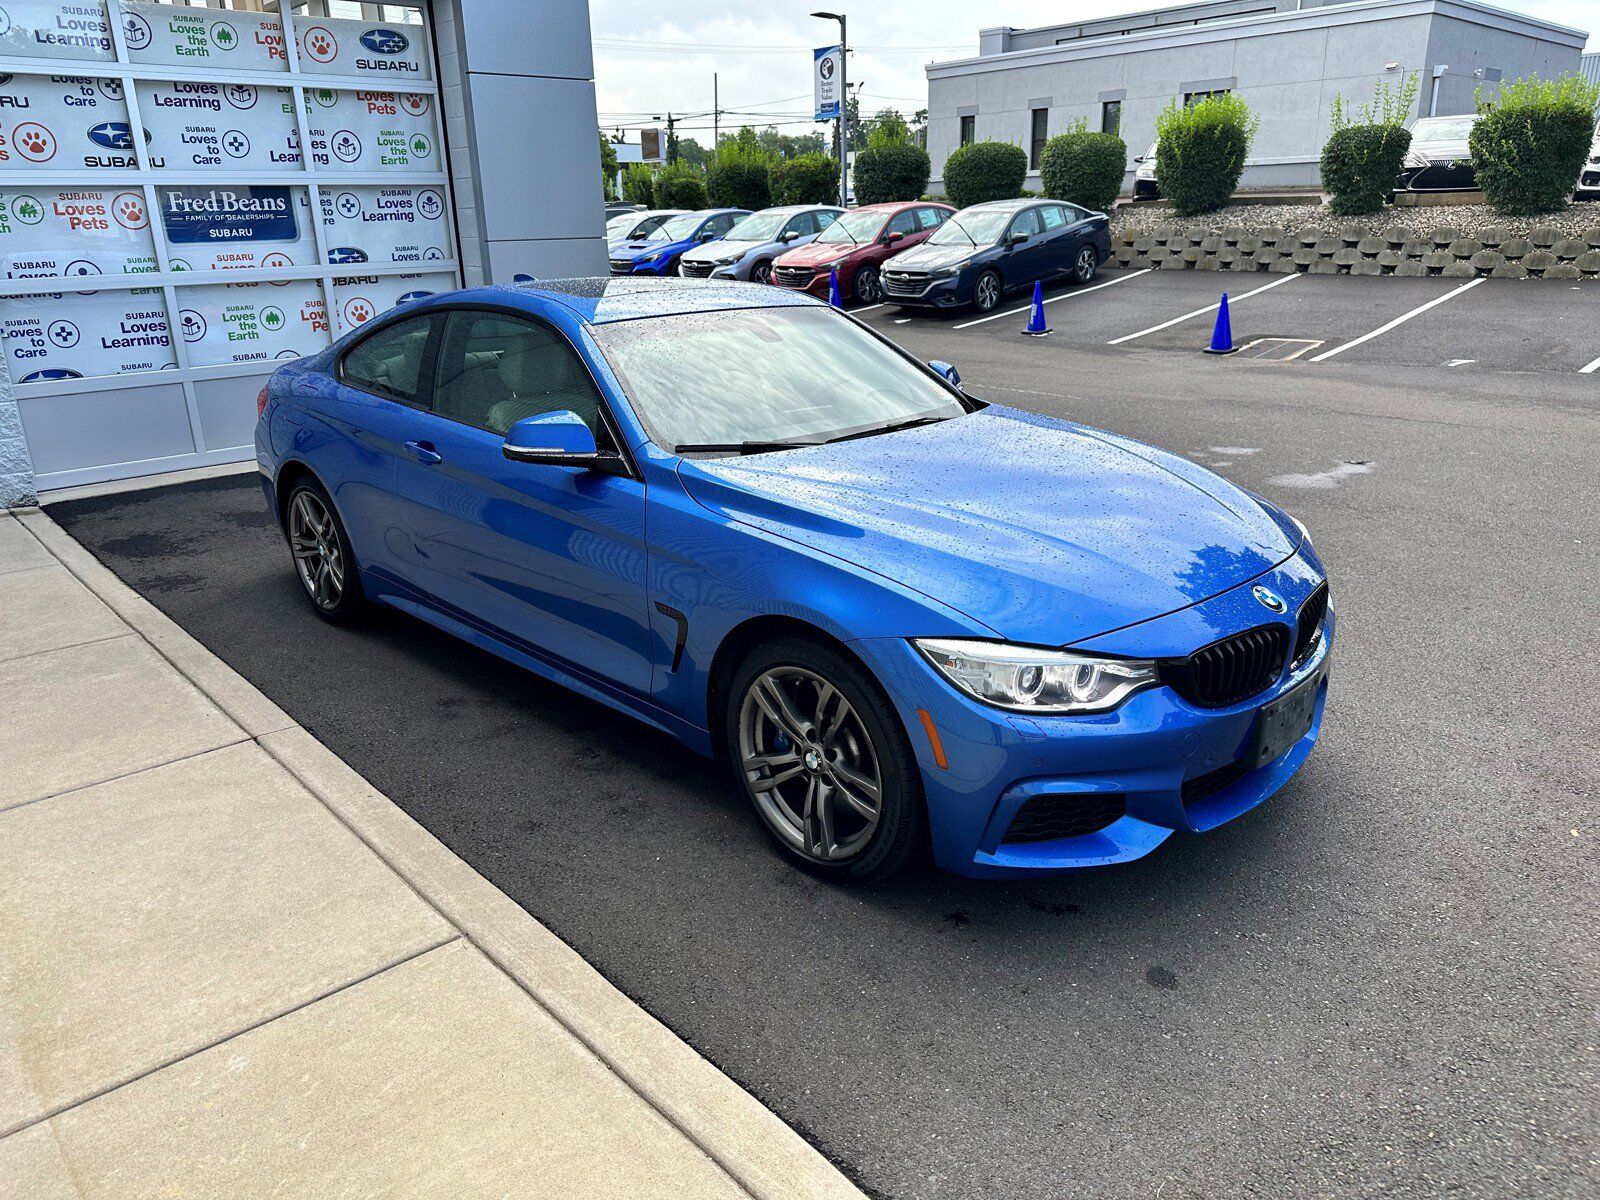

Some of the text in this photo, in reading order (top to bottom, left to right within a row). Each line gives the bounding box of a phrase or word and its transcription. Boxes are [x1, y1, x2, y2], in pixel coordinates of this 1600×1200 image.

[56, 16, 108, 32] Loves
[173, 15, 204, 24] SUBARU
[169, 22, 206, 36] Loves
[35, 30, 111, 50] Learning
[187, 34, 208, 46] the
[175, 45, 210, 58] Earth
[356, 59, 419, 72] SUBARU
[80, 86, 94, 96] to
[173, 82, 219, 95] Loves
[64, 95, 97, 107] Care
[154, 94, 221, 111] Learning
[367, 102, 397, 115] Pets
[292, 128, 325, 136] SARU
[181, 133, 218, 145] Loves
[377, 136, 406, 147] Loves
[206, 144, 220, 155] to
[390, 146, 408, 156] the
[192, 154, 222, 165] Care
[270, 150, 330, 165] Learng
[381, 156, 408, 166] Earth
[58, 192, 103, 201] SUBARU
[52, 202, 106, 216] Loves
[376, 198, 413, 209] Loves
[322, 207, 334, 216] to
[362, 210, 414, 222] Learning
[69, 216, 109, 230] Pets
[210, 228, 253, 238] SUBARU
[216, 254, 254, 262] SUBARU
[392, 252, 420, 262] Loves
[12, 261, 56, 270] SUBARU
[125, 310, 164, 320] SUBARU
[222, 312, 256, 323] Loves
[5, 318, 40, 327] SUBARU
[120, 321, 167, 334] Loves
[238, 322, 258, 331] the
[101, 333, 170, 350] Learning
[228, 330, 260, 342] Earth
[30, 338, 45, 347] to
[14, 348, 48, 359] Care
[232, 352, 267, 362] SUBARU
[121, 362, 153, 370] SUBARU
